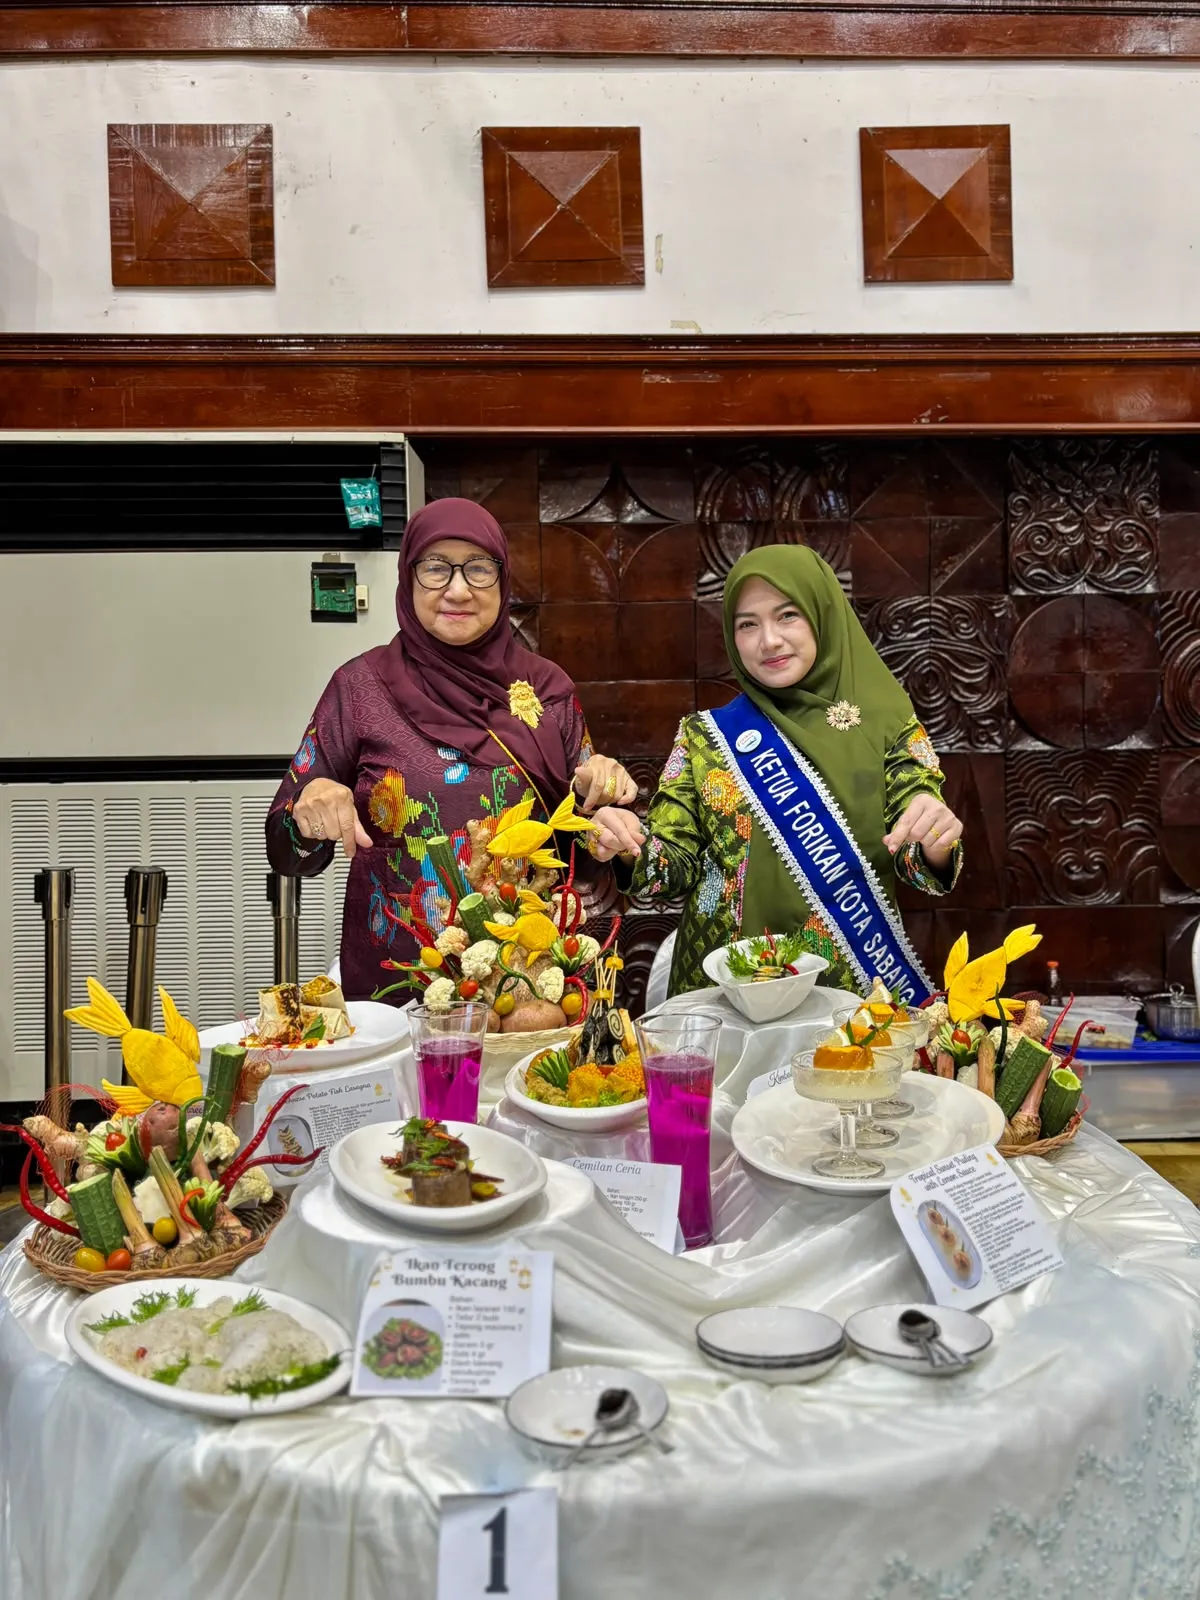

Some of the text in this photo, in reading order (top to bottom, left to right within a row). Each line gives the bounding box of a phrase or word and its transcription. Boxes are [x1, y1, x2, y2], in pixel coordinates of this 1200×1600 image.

[750, 748, 915, 1005] KETUA FORIKAN KOTA SABANG
[306, 1091, 328, 1100] Potato
[329, 1087, 343, 1096] Fish
[344, 1081, 371, 1093] Lasagna
[573, 1159, 642, 1175] Cemilan Ceria
[908, 1167, 937, 1183] Tropical
[934, 1160, 956, 1174] Sunset
[924, 1166, 976, 1191] with Lemon Sauce
[404, 1258, 496, 1274] Ikan Terong
[391, 1274, 508, 1290] Bumbu Kacang
[482, 1505, 509, 1594] 1
